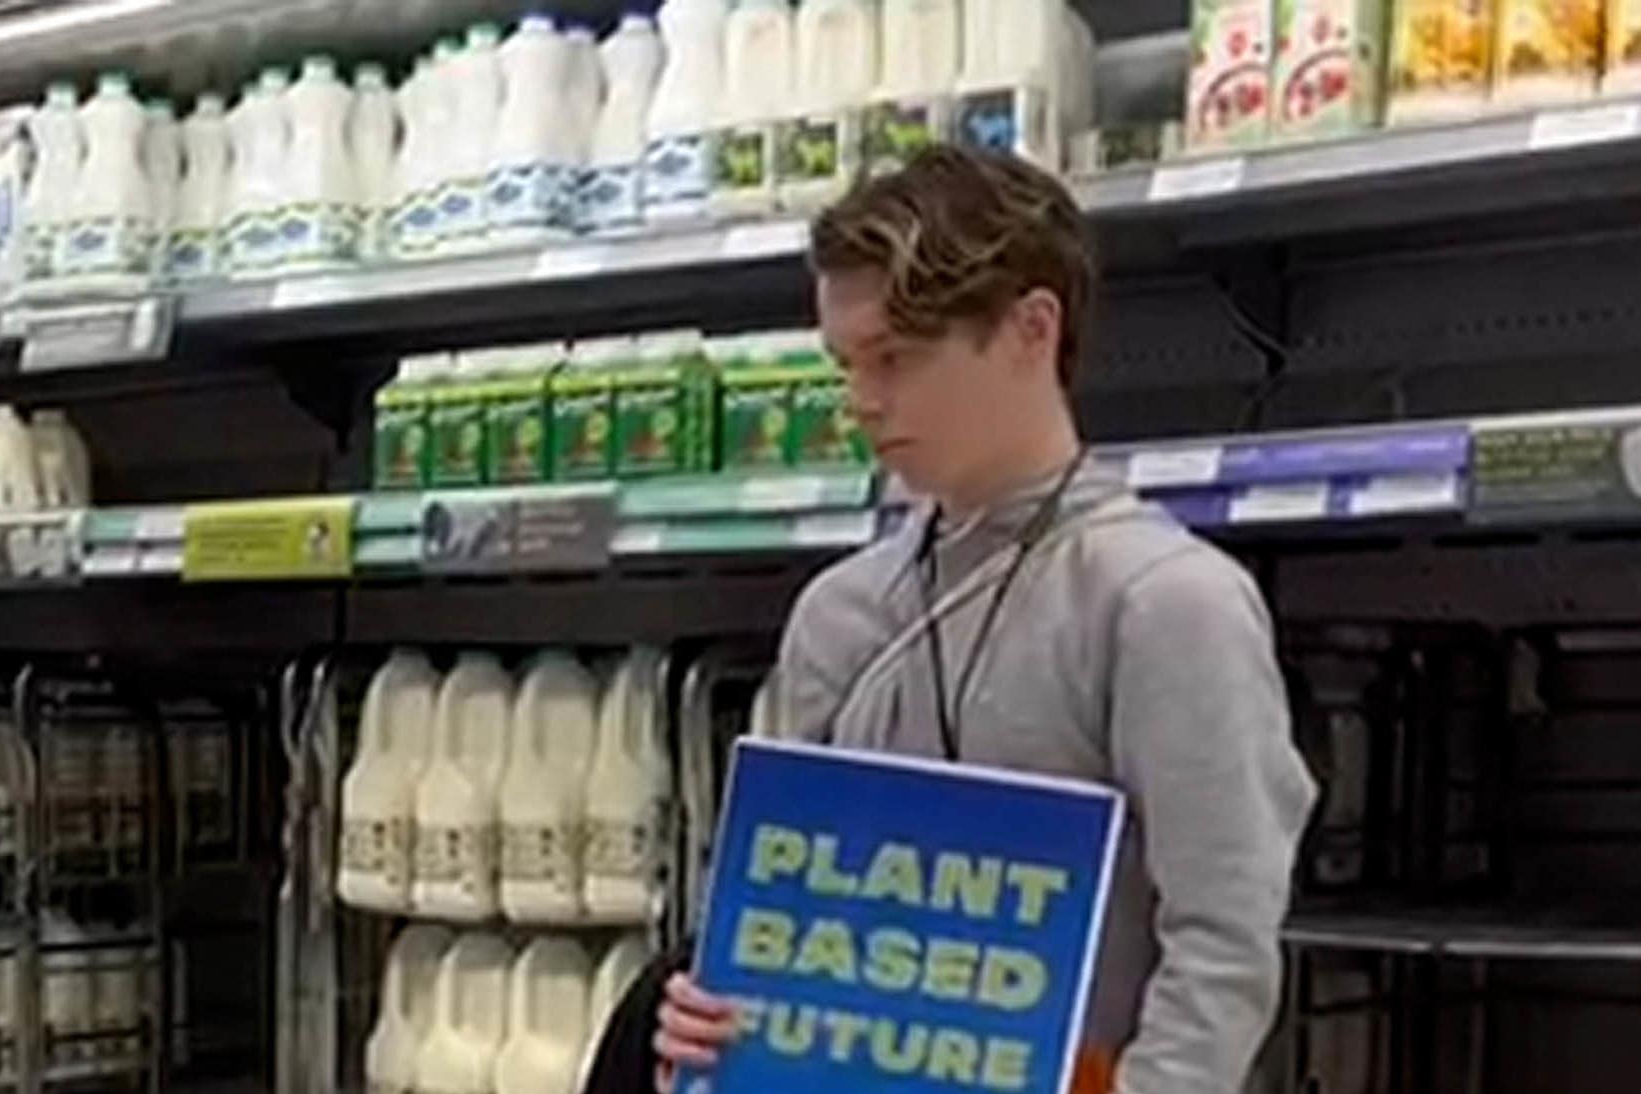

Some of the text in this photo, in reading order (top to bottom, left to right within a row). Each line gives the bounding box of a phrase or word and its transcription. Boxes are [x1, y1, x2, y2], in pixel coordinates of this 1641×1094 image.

[747, 823, 1068, 925] PLANT
[734, 910, 1048, 1009] BASED
[734, 997, 1032, 1089] FUTURE
